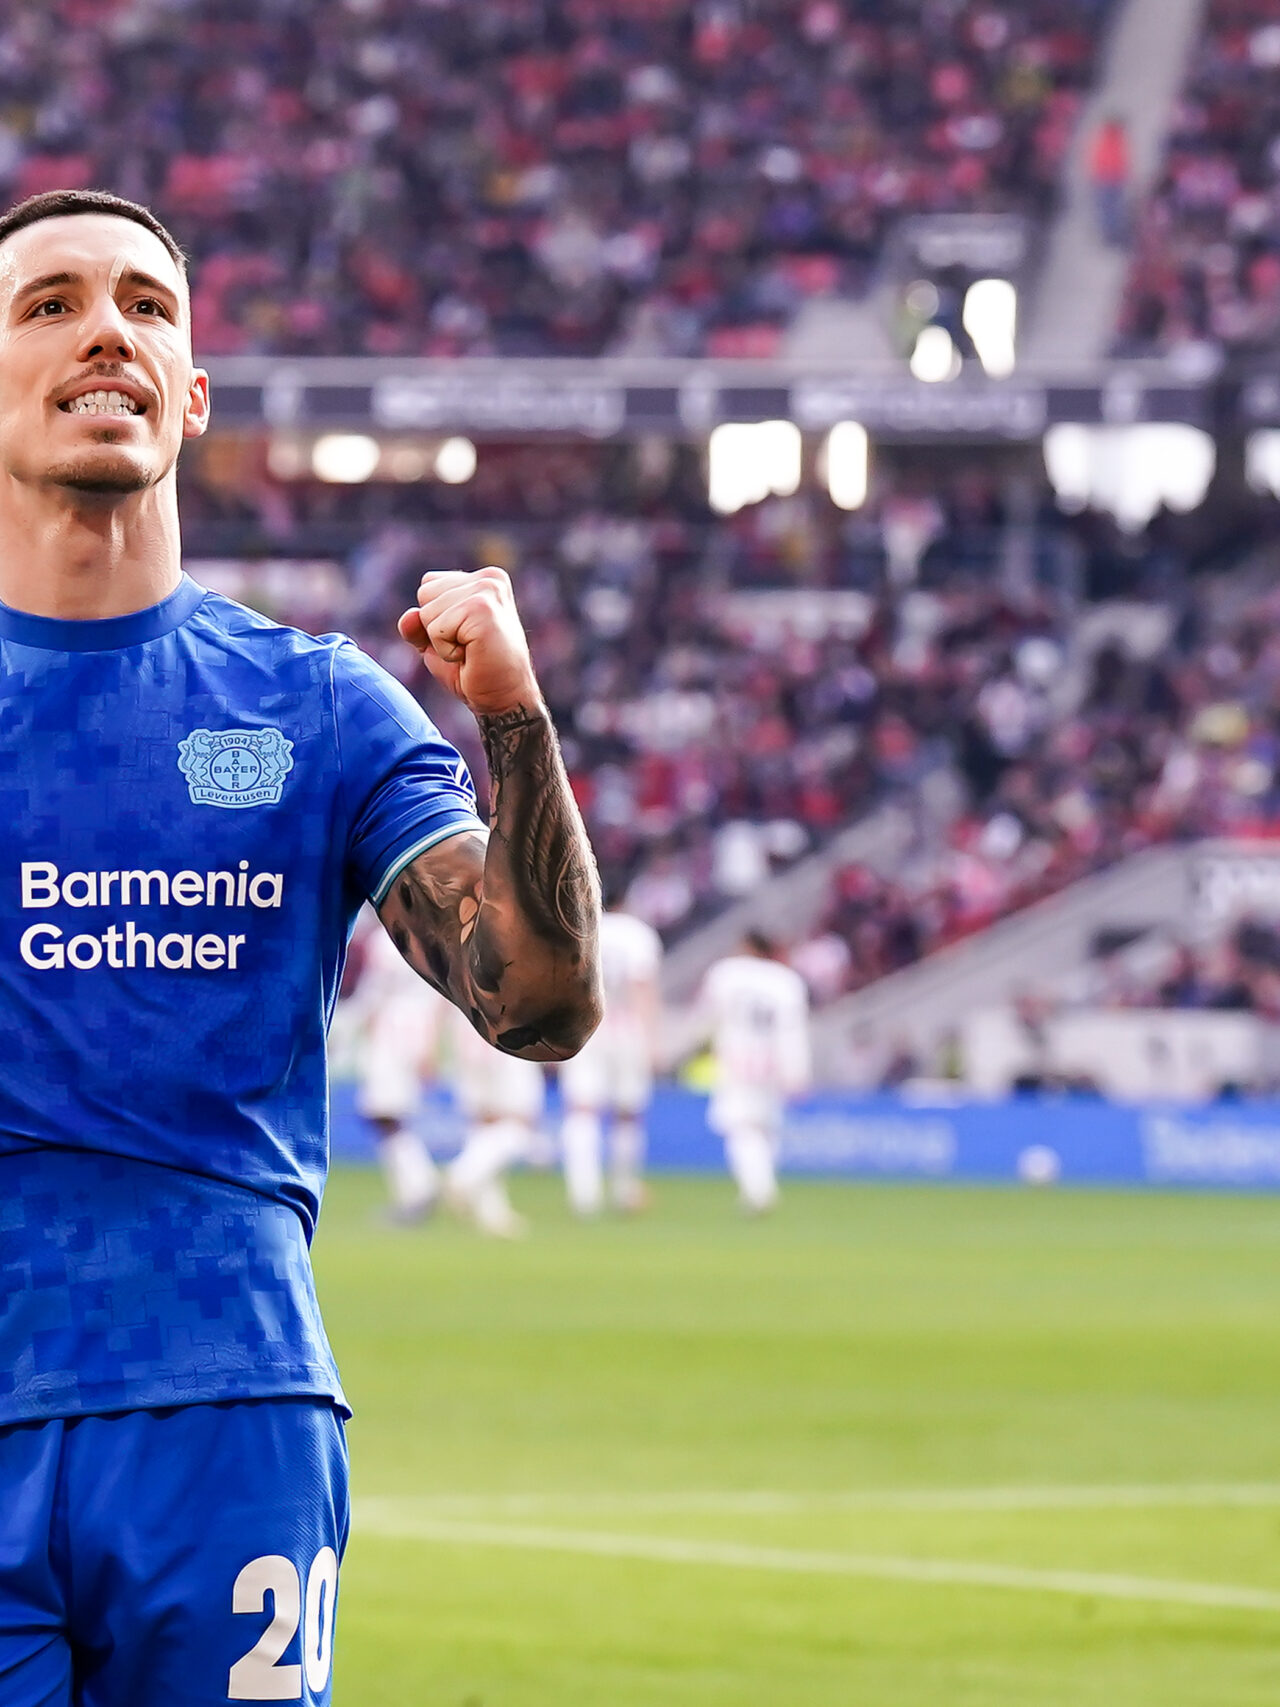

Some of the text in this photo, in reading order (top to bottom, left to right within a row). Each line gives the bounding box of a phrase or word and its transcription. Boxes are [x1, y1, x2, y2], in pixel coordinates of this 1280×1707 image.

[223, 737, 247, 746] 1904
[213, 765, 258, 774] BAYER
[231, 751, 240, 789] BAYER
[200, 789, 271, 802] Leverkusen
[21, 860, 283, 908] Barmenia
[20, 921, 246, 970] Gothaer
[227, 1546, 338, 1701] 20
